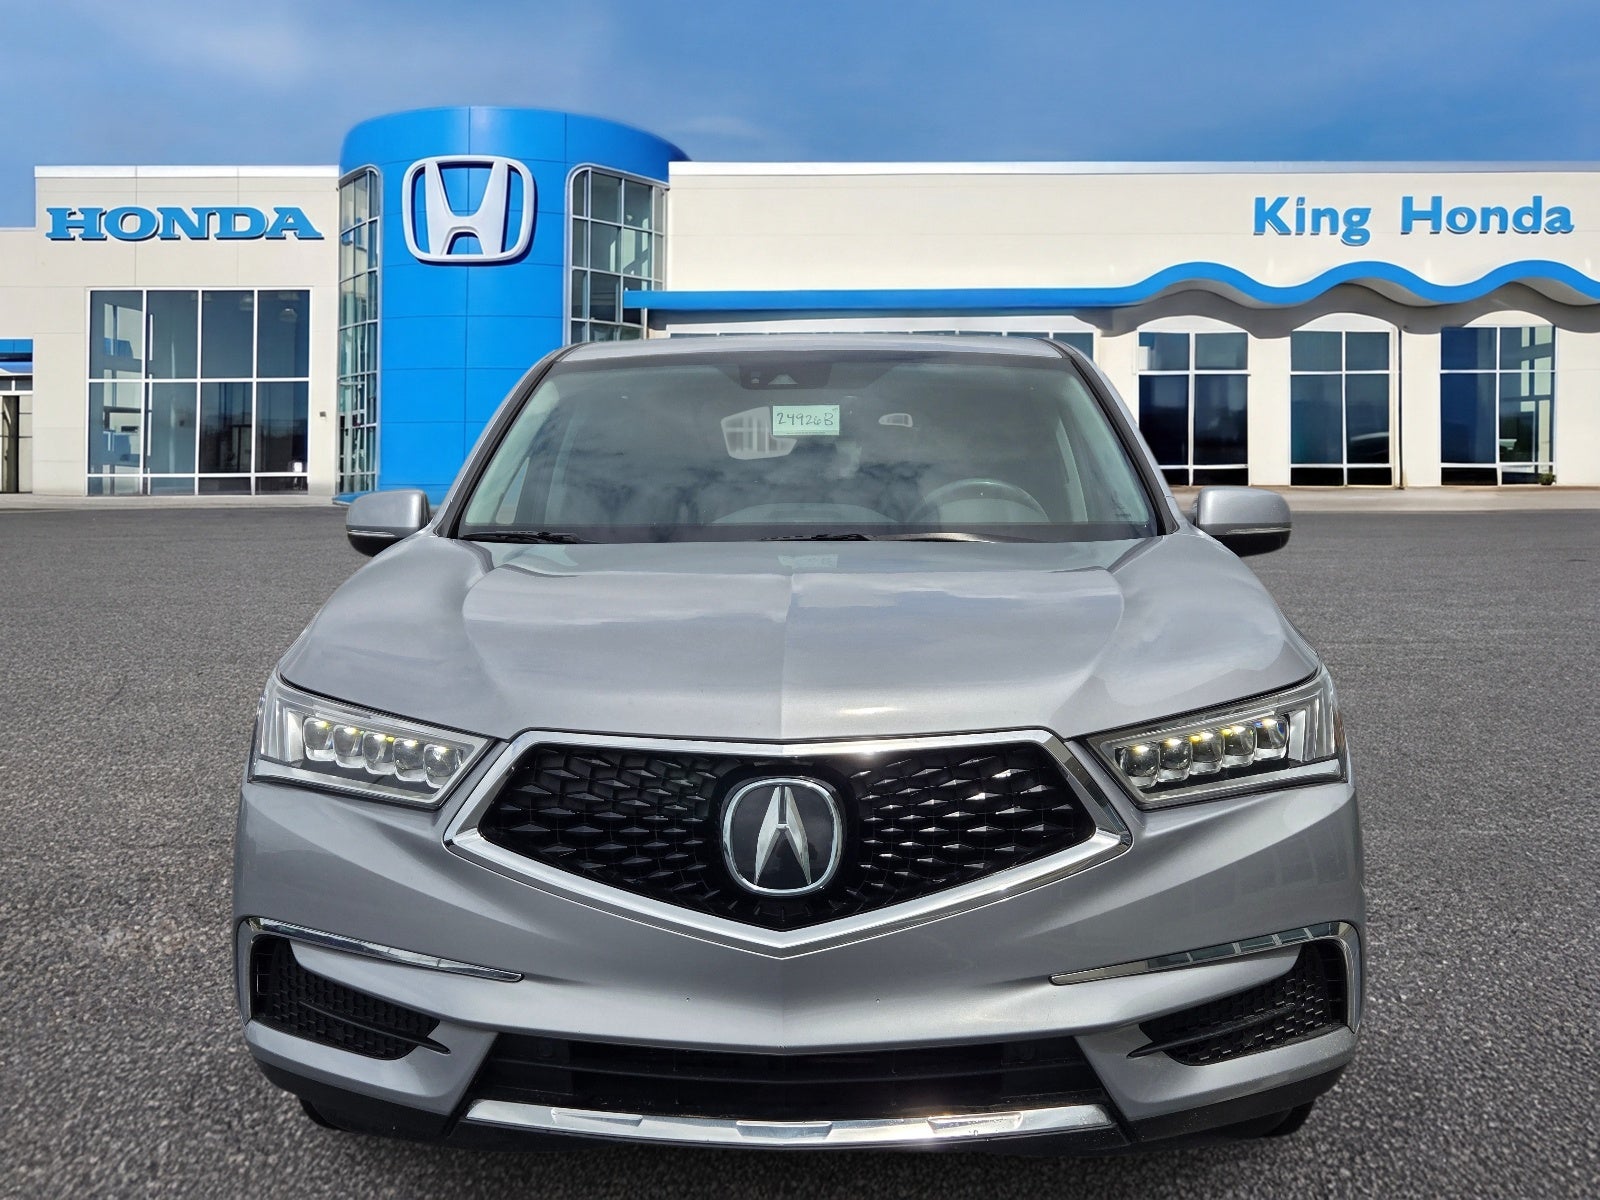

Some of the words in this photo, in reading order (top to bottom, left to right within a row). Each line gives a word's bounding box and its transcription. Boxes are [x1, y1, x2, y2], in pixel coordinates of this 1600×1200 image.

[45, 206, 324, 242] HONDA
[1253, 196, 1372, 246] King
[1401, 195, 1575, 234] Honda
[776, 412, 834, 426] 24926B
